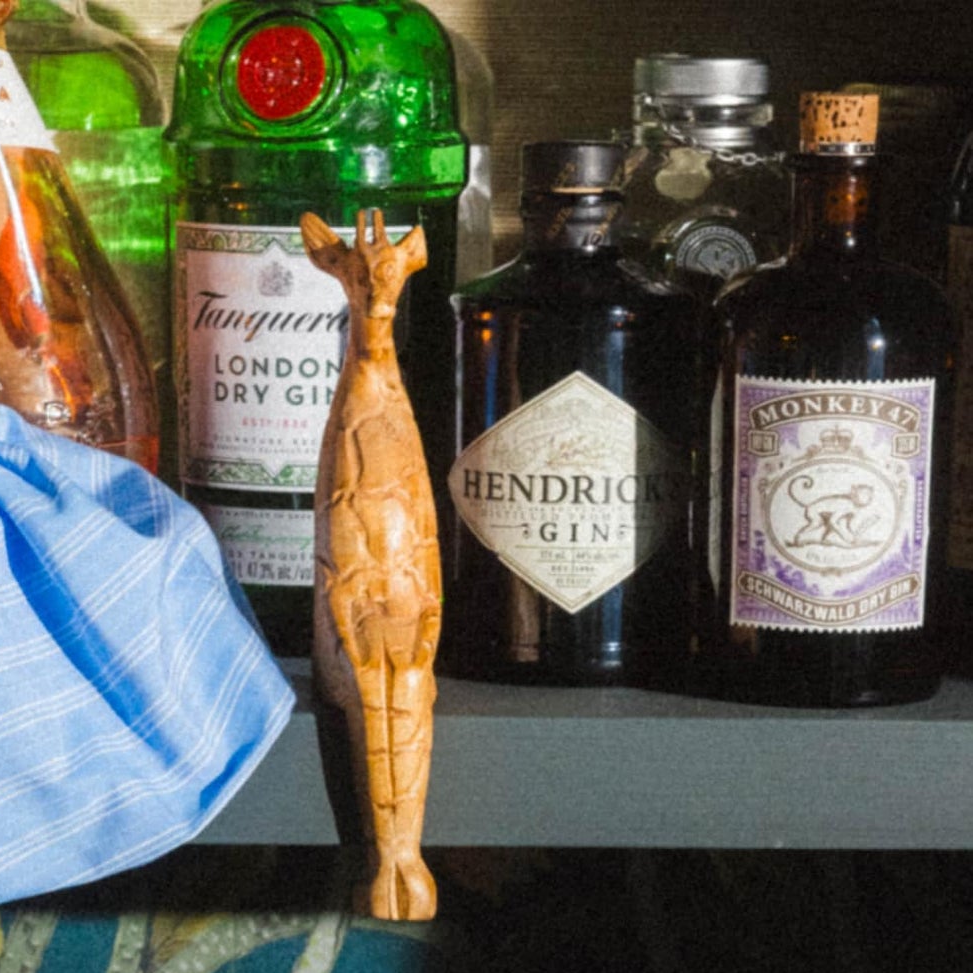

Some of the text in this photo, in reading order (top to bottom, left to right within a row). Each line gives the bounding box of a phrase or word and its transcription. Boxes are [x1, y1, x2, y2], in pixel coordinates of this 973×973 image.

[193, 290, 349, 343] Tanquera
[214, 353, 344, 379] LONDON
[215, 381, 269, 405] DRY
[757, 395, 916, 427] MONKEY 47
[463, 468, 663, 506] HENDRICK
[539, 522, 609, 543] GIN
[746, 576, 855, 623] SCHWARZWALD
